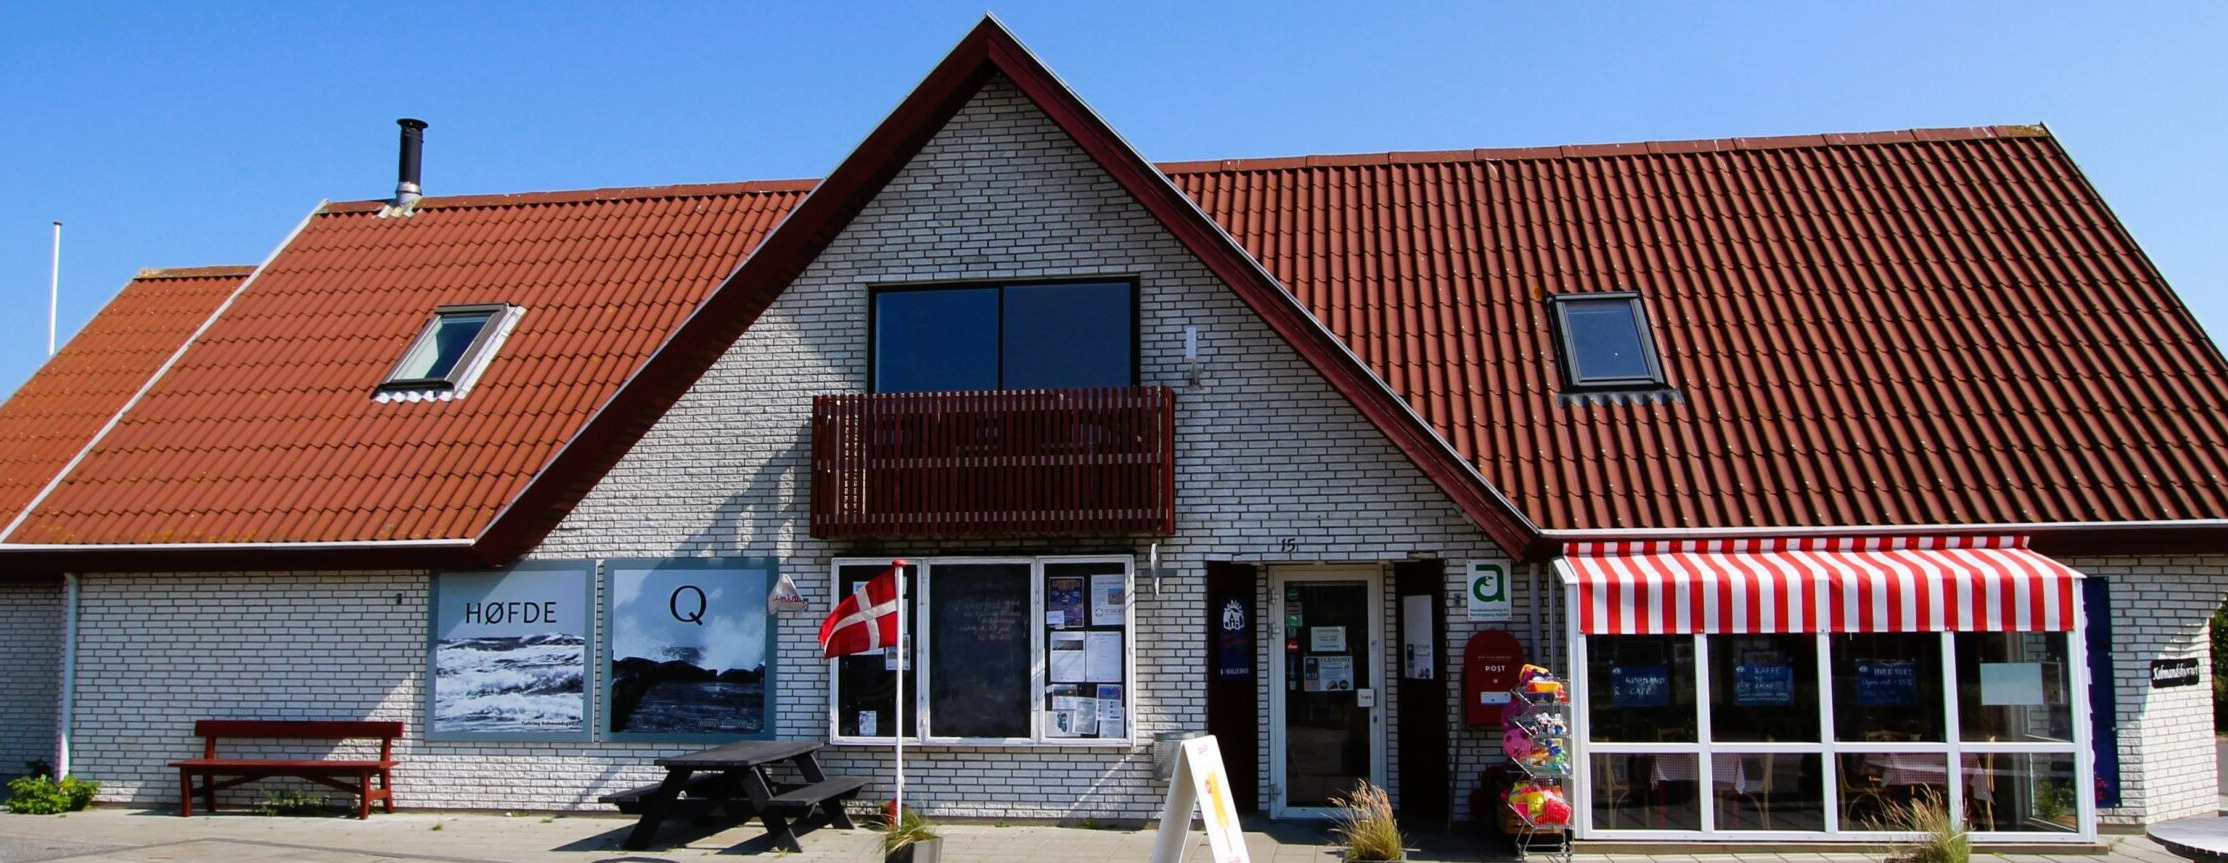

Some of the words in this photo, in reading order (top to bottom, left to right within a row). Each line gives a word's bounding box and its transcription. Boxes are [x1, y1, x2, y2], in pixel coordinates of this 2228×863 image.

[1281, 538, 1296, 554] 15
[465, 601, 557, 625] HØFDE
[669, 585, 707, 626] Q
